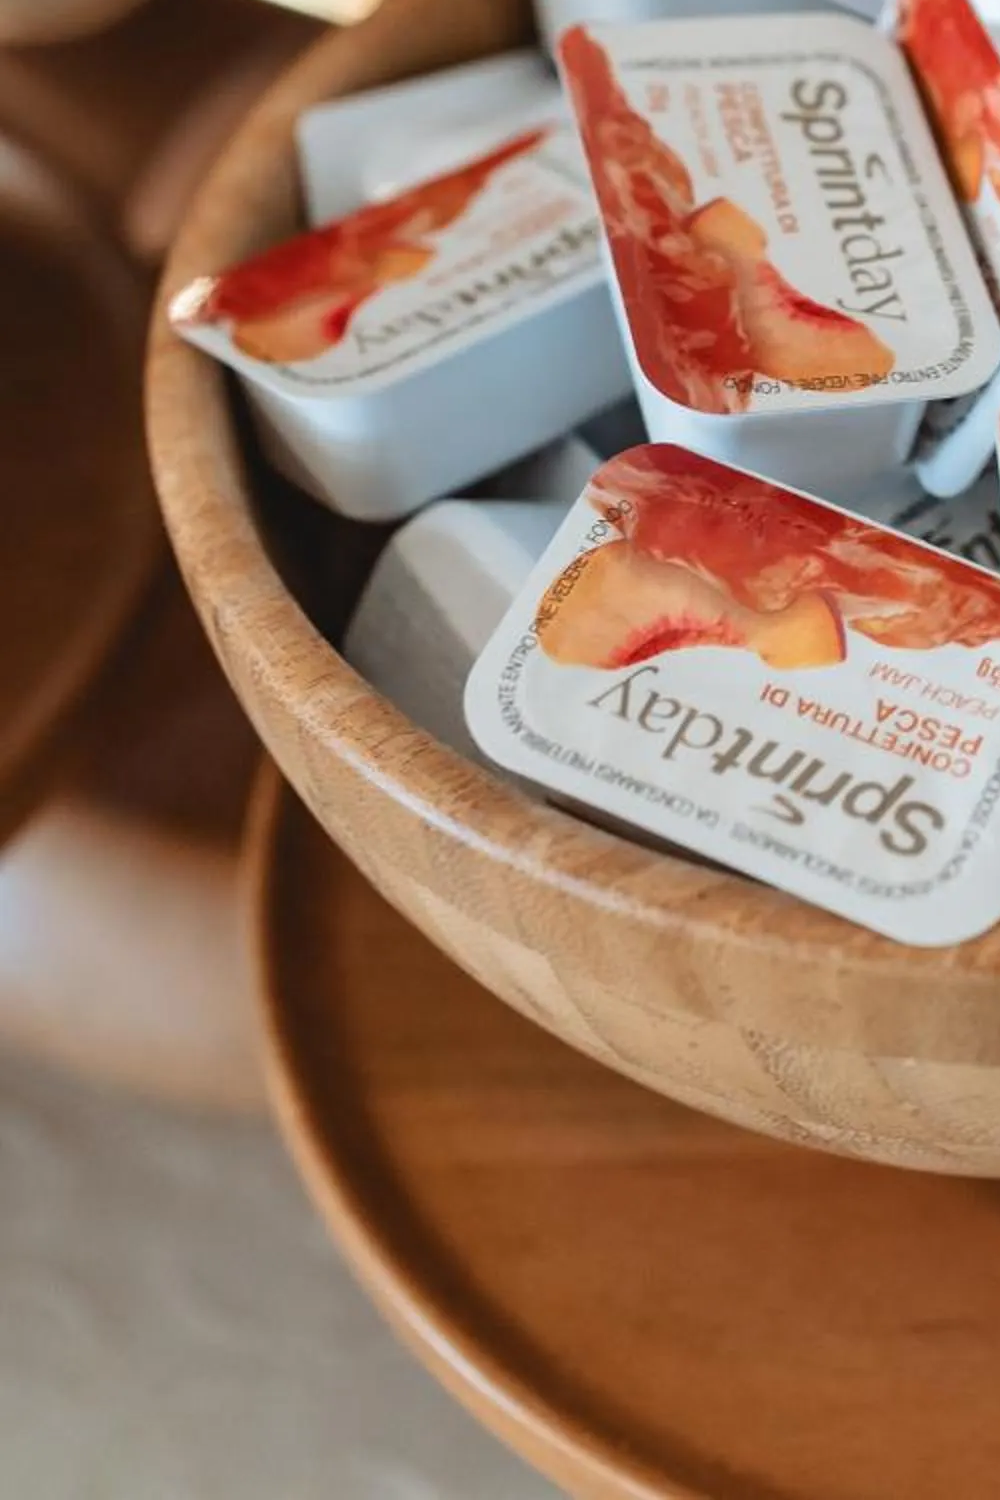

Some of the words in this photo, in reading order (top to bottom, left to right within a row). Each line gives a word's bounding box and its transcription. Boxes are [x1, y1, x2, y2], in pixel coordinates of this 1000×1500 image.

[780, 78, 908, 322] Sprintday
[500, 633, 538, 684] ENTRO
[586, 499, 634, 543] FONDO
[759, 683, 791, 709] DI
[868, 660, 921, 690] JAM
[586, 665, 945, 858] Sprintday
[797, 696, 972, 778] CONFETTURA
[876, 699, 984, 756] PESCA
